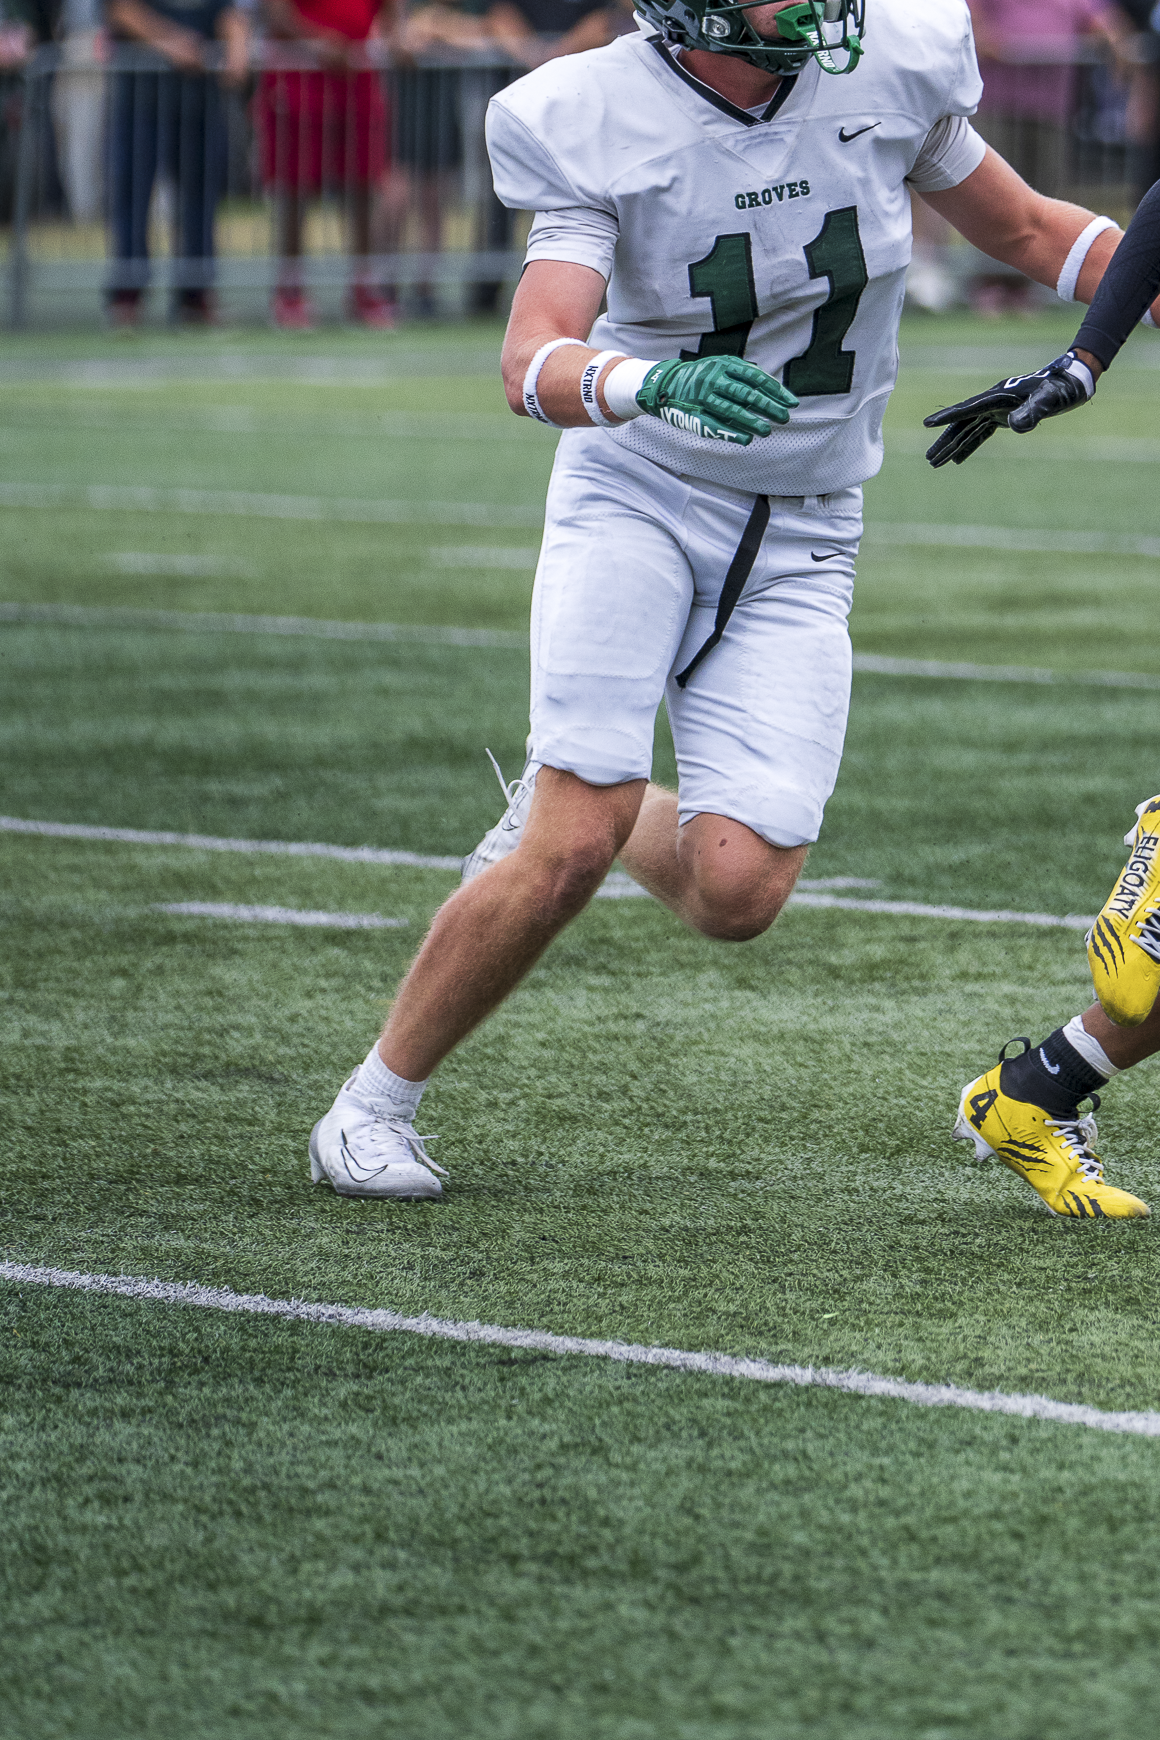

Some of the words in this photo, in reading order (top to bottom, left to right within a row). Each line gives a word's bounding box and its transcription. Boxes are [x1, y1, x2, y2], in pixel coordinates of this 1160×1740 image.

[734, 180, 811, 210] GROVES
[679, 205, 869, 397] 11
[583, 365, 599, 403] NXTRND
